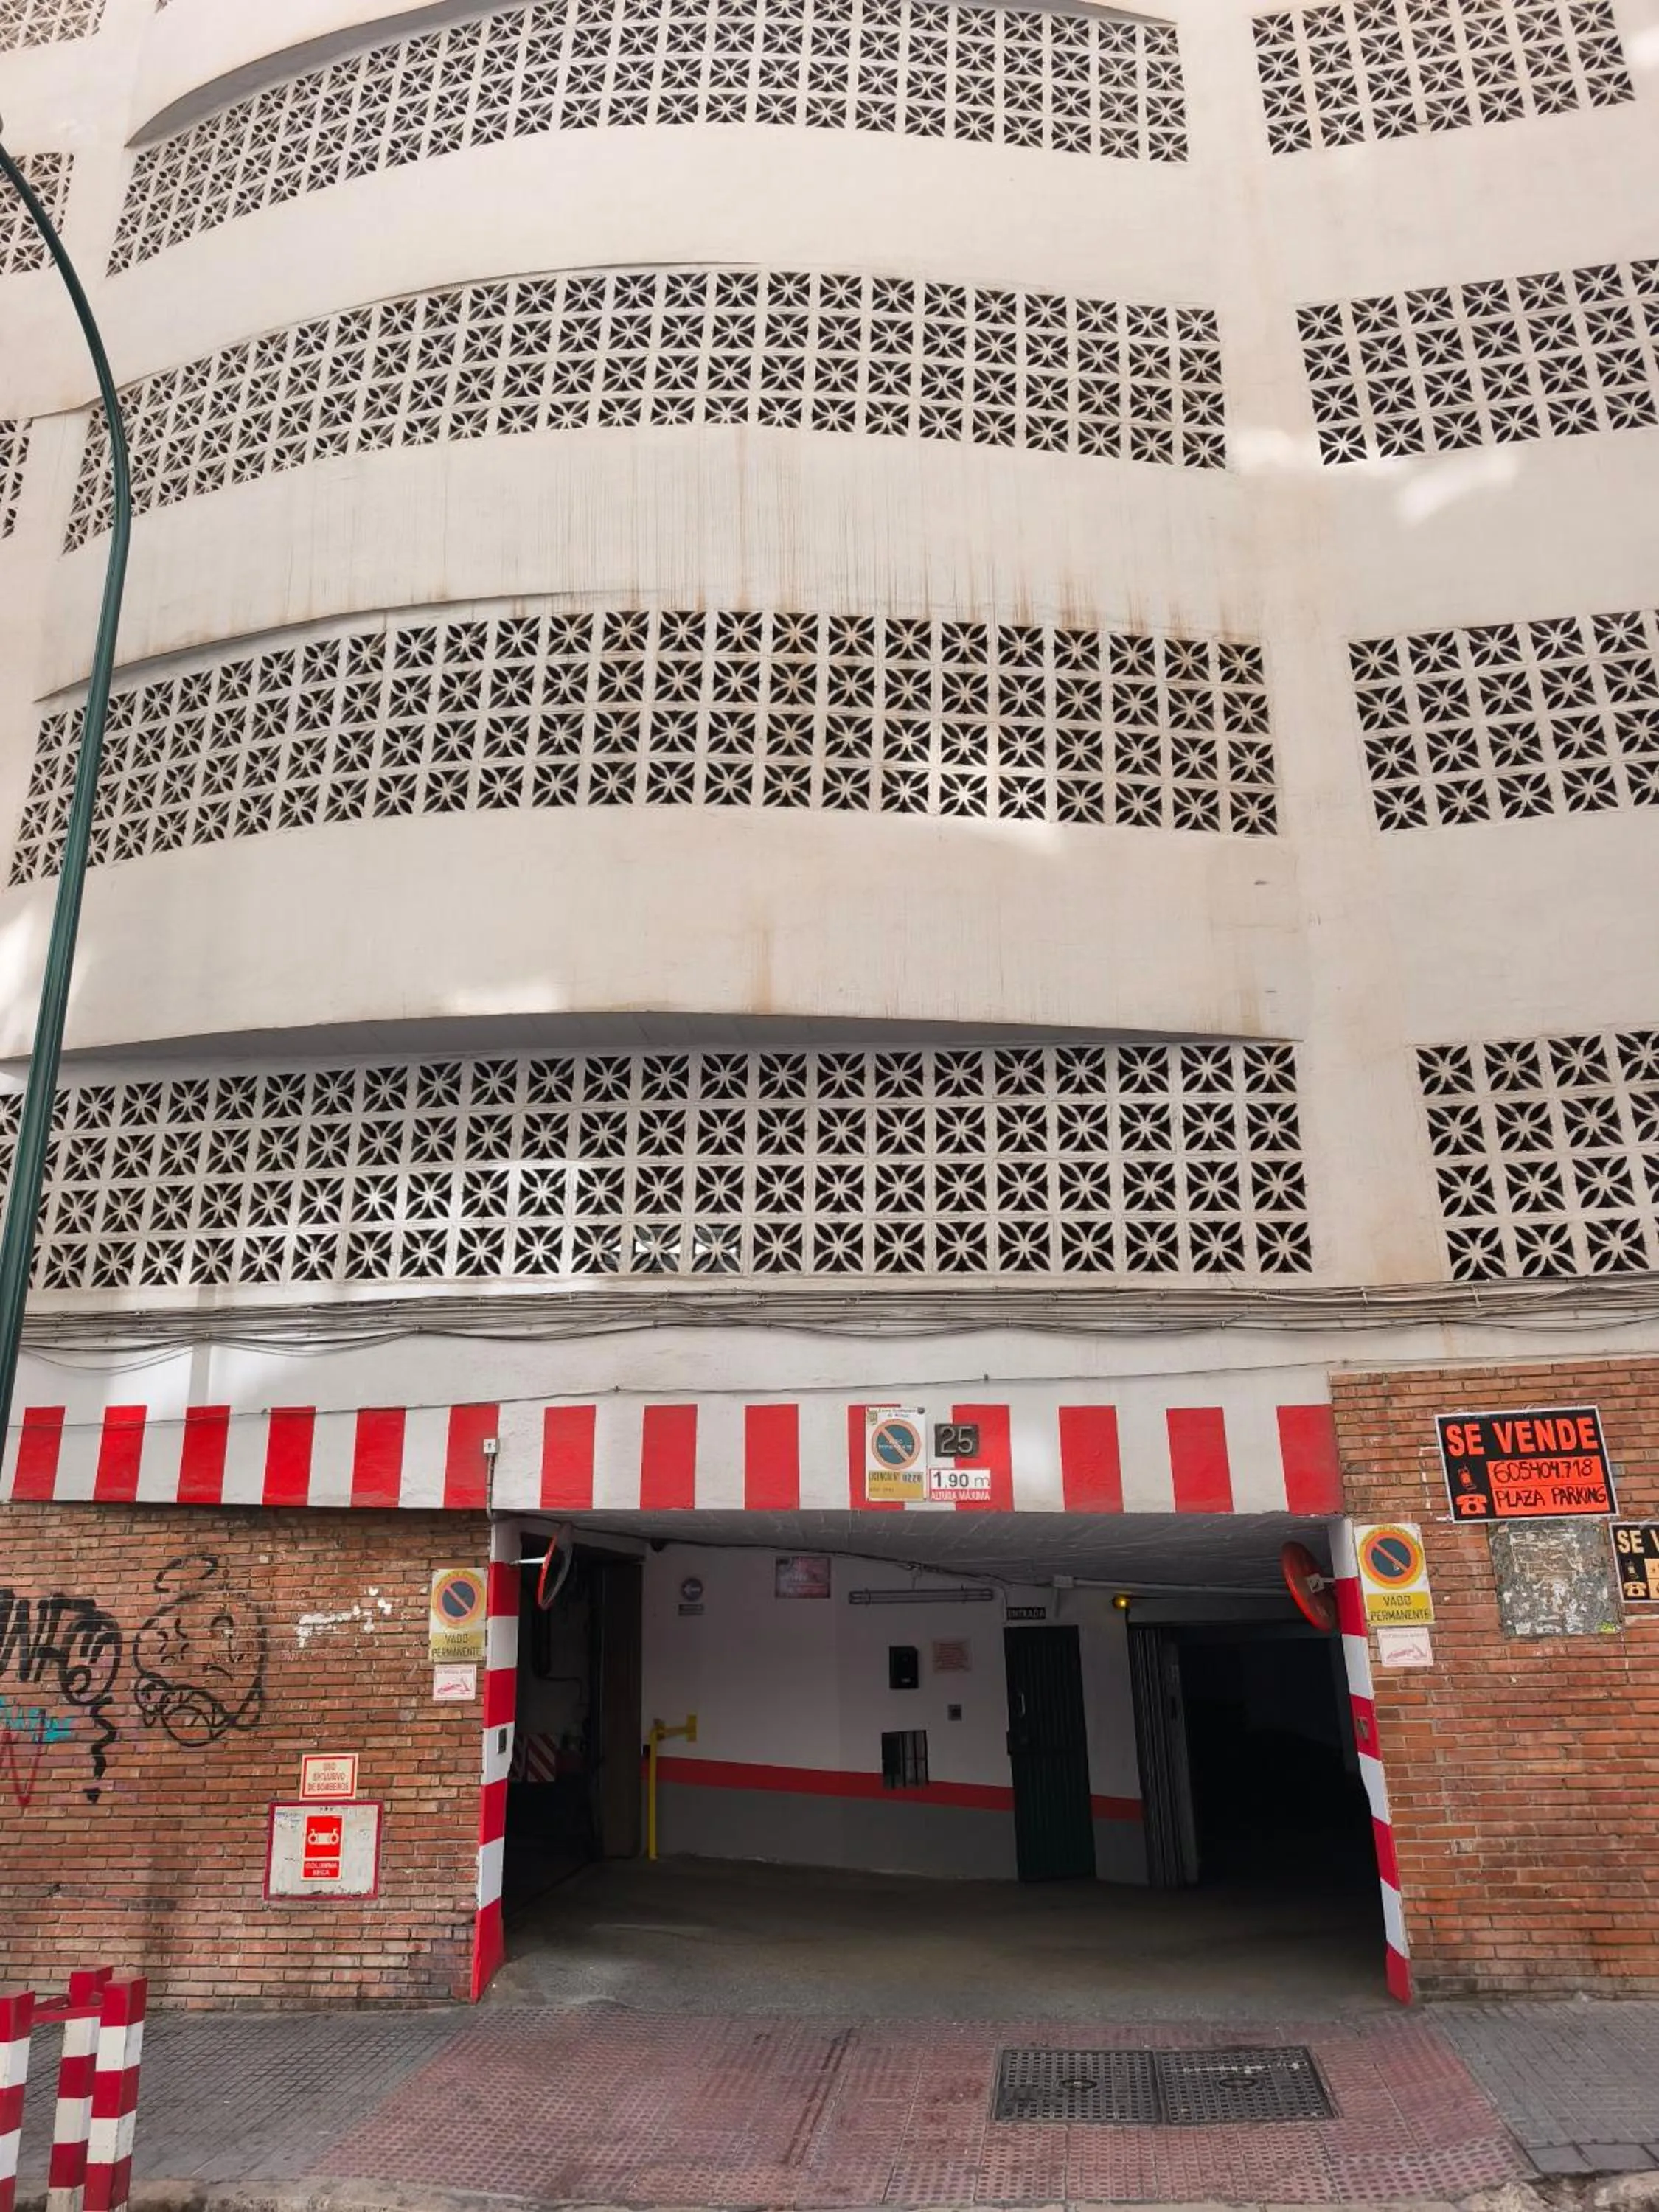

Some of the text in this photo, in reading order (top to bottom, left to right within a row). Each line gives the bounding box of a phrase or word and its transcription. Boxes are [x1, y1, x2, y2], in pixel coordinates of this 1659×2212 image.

[940, 1425, 973, 1453] 25
[1446, 1416, 1599, 1457] SE VENDE
[974, 1476, 990, 1487] m
[1495, 1486, 1607, 1508] PLAZA PARKING
[1617, 1529, 1645, 1554] SE
[1382, 1595, 1412, 1607] VADO
[1370, 1608, 1430, 1621] PERMANENTE
[445, 1633, 468, 1644] VADO
[431, 1646, 483, 1658] PERMANENTE
